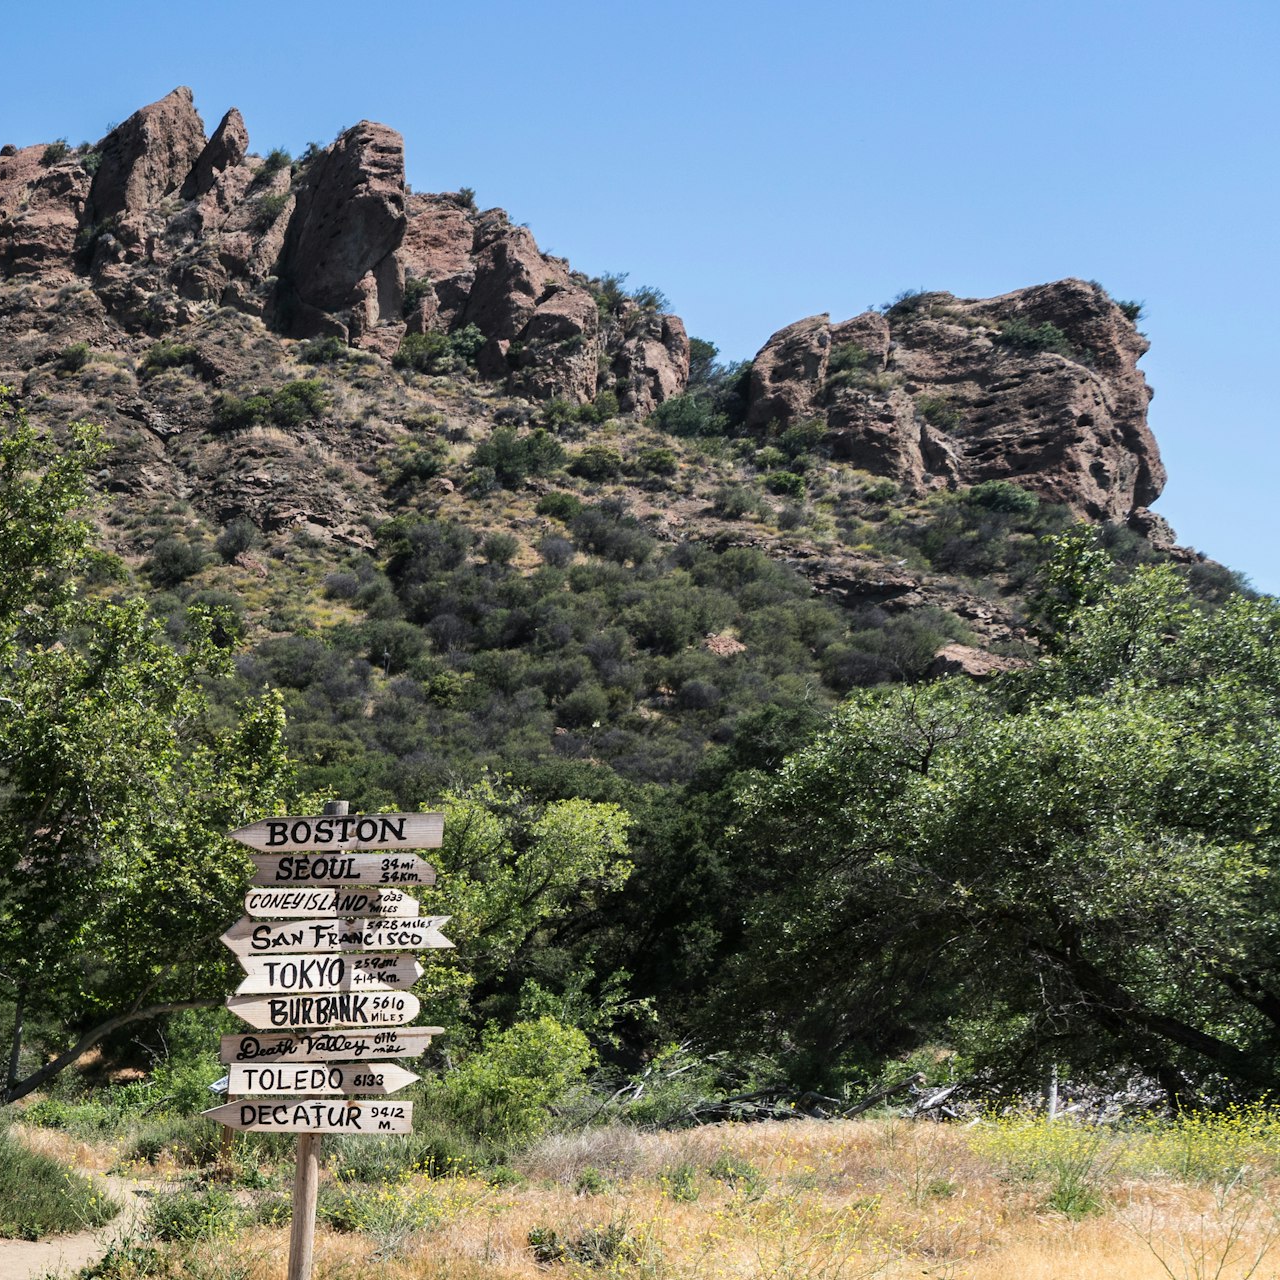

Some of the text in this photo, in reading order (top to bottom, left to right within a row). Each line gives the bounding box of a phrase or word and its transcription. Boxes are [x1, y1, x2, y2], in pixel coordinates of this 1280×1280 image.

[265, 817, 407, 846] BOSTON
[275, 856, 360, 881] SEOUL
[381, 858, 399, 871] 34
[249, 892, 369, 911] CONEY ISLAND
[376, 892, 403, 902] 7033
[369, 905, 398, 913] MILES
[366, 919, 398, 931] 5428
[263, 957, 345, 989] TOKYO
[268, 994, 369, 1026] BURBANK
[372, 996, 405, 1011] 5610
[236, 1034, 370, 1060] Death Valley
[242, 1068, 344, 1090] TOLEDO
[240, 1104, 405, 1129] DECATUR 9412
[378, 1120, 395, 1130] M.
